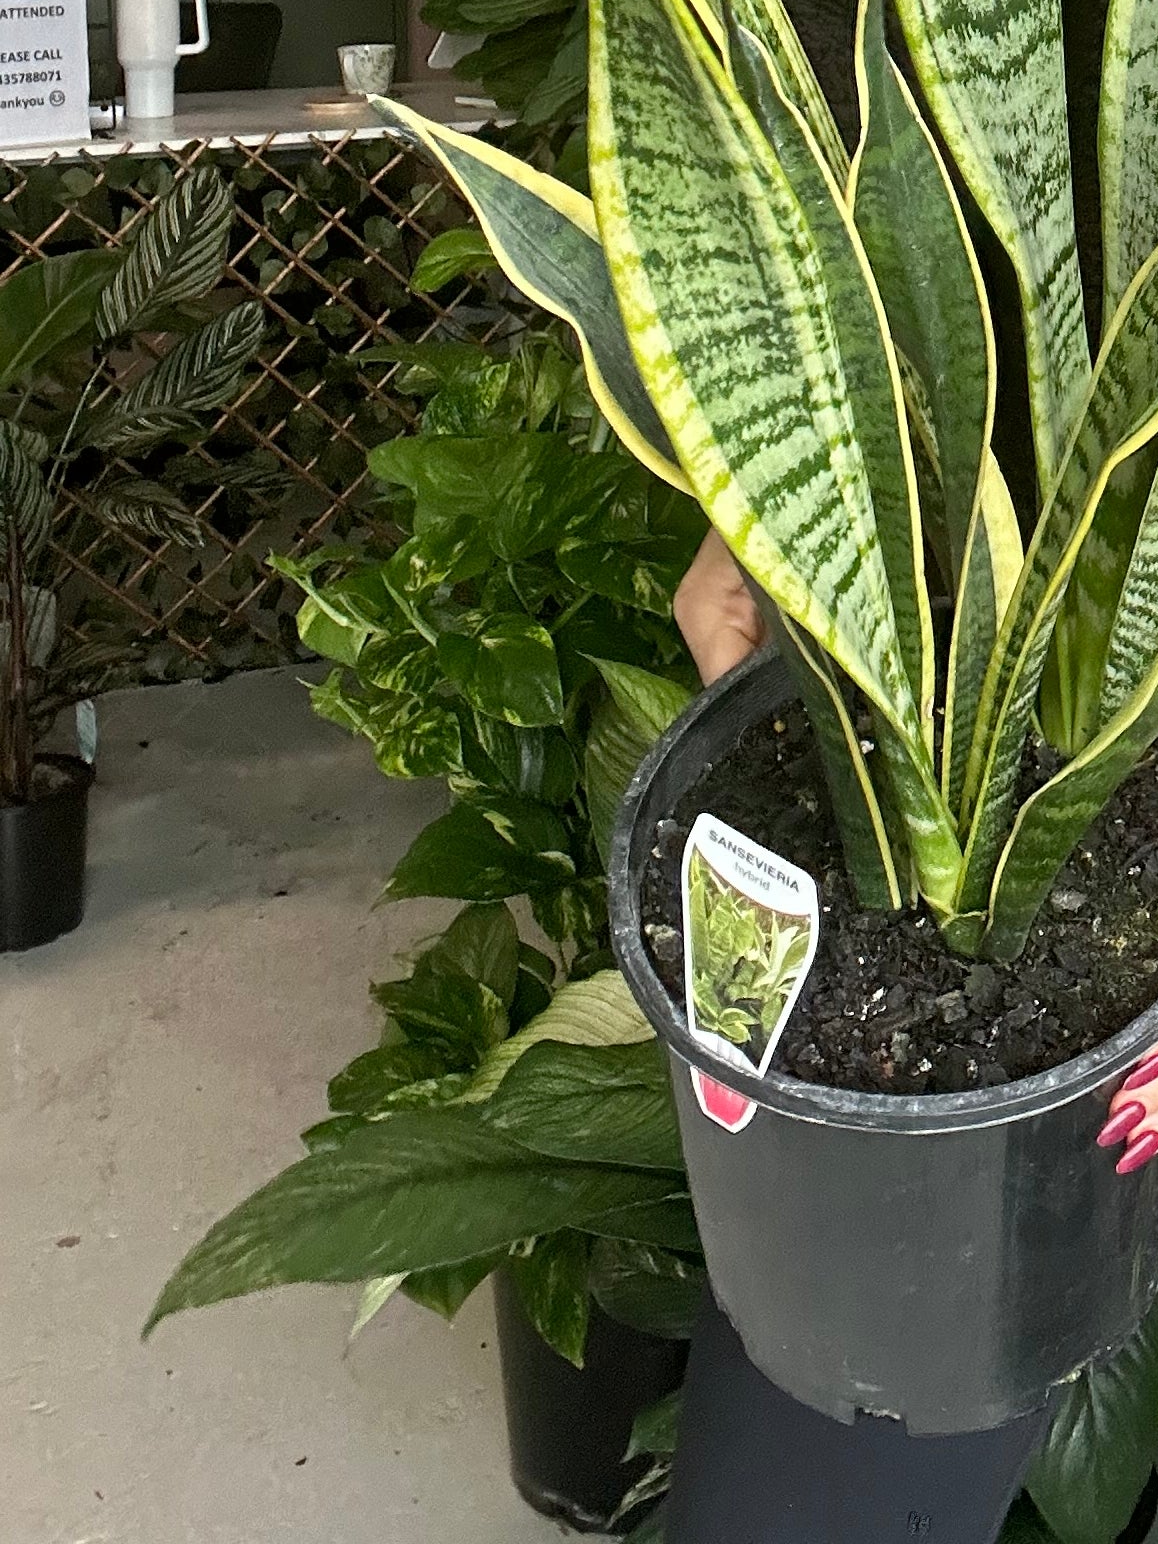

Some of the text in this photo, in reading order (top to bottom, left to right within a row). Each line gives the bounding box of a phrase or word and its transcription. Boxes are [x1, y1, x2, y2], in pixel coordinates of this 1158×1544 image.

[0, 5, 65, 20] ATTENDED
[0, 48, 63, 64] EASE CALL
[0, 95, 45, 110] ankyou
[709, 829, 800, 893] SANSEVIERIA
[733, 861, 771, 892] hybrid
